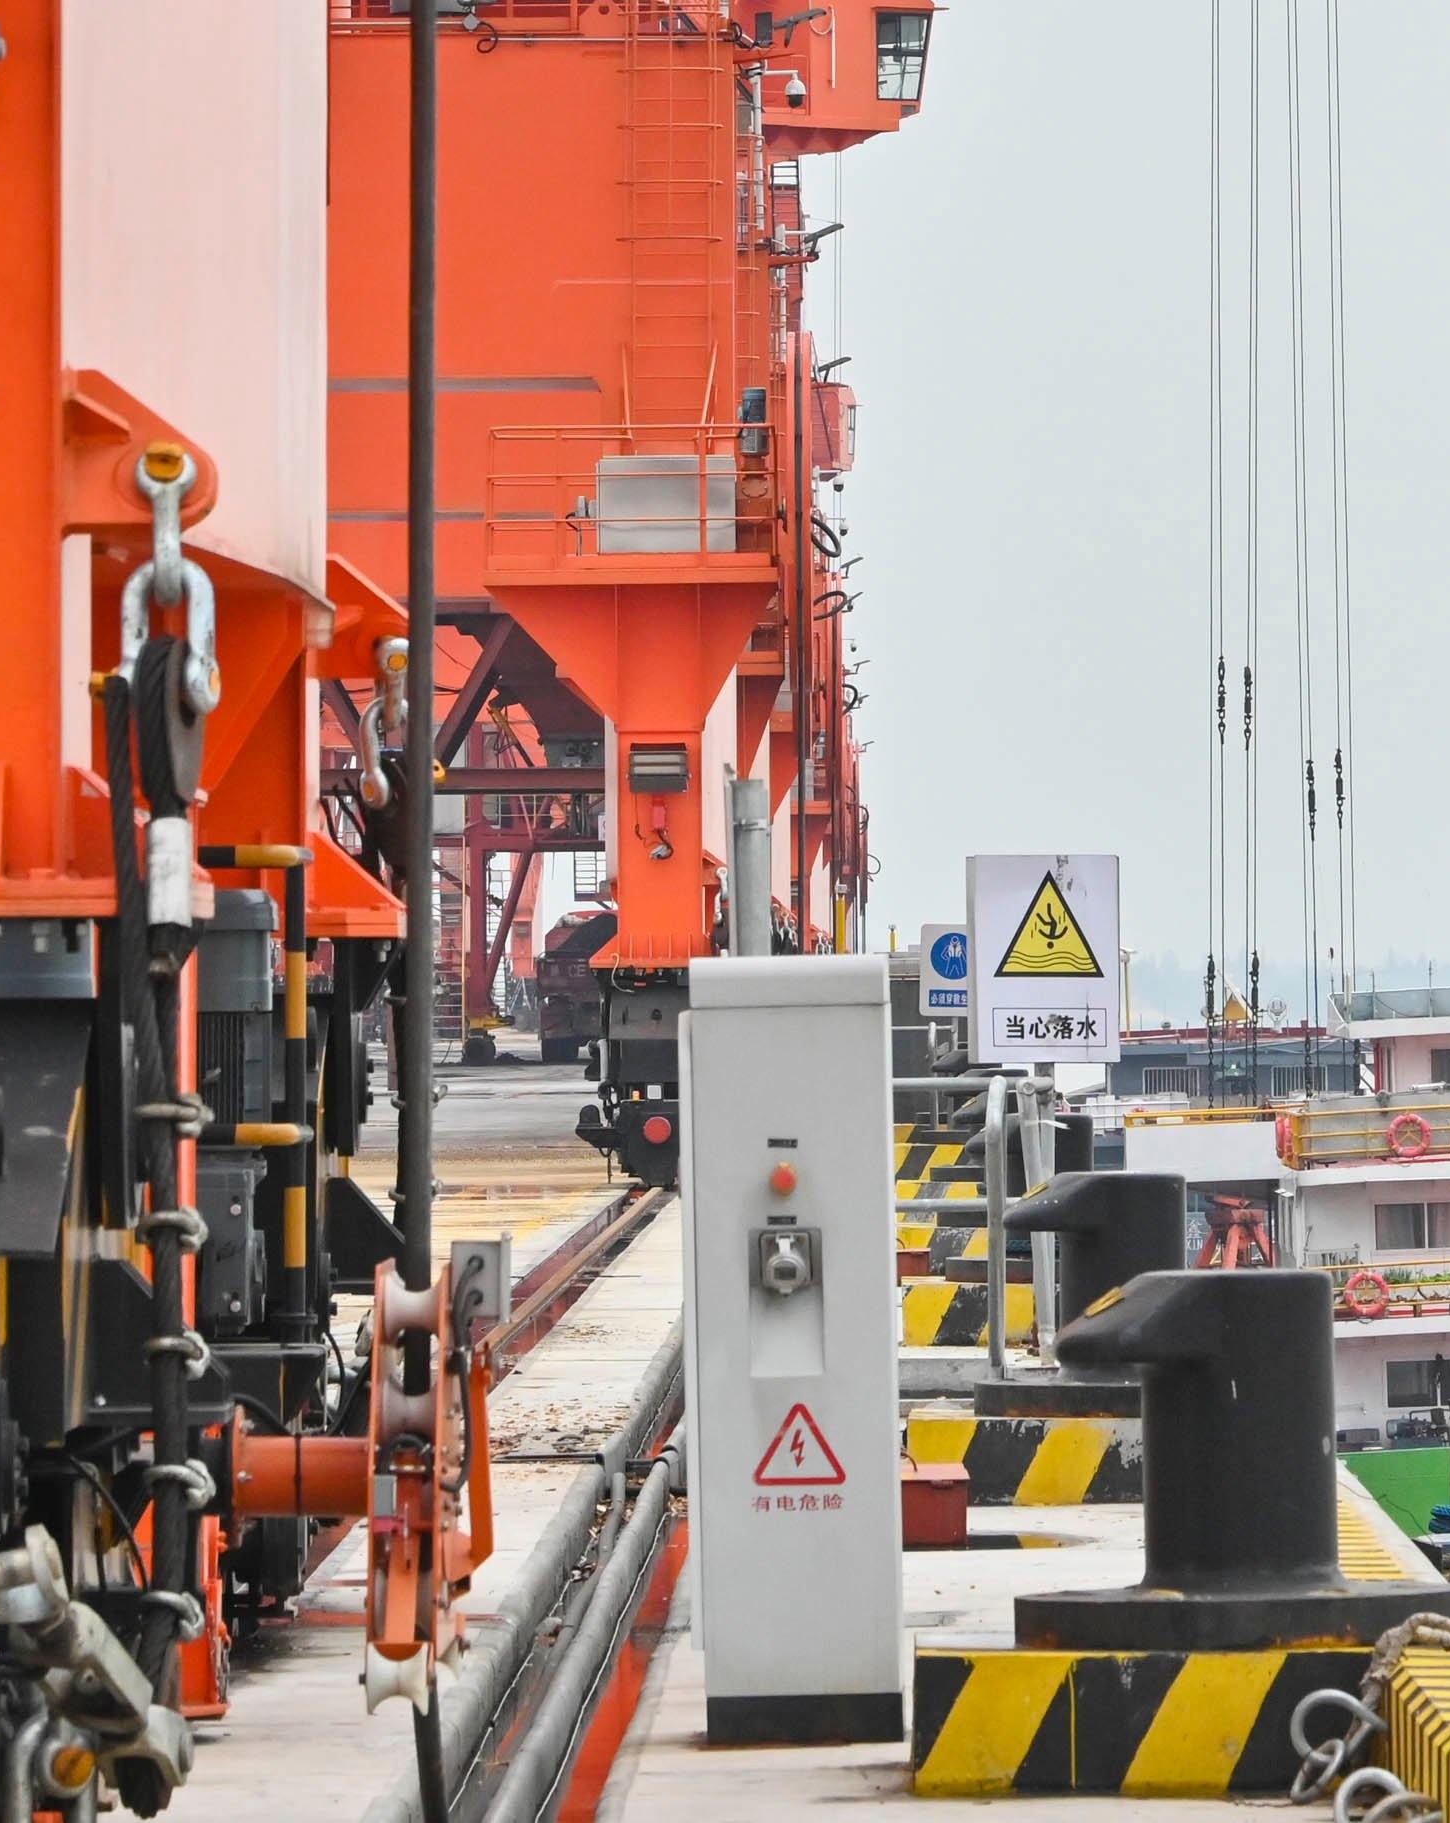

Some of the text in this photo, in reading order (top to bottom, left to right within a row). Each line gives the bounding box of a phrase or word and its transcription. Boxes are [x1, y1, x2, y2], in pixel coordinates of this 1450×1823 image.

[930, 992, 968, 1005] 必须穿救生
[1006, 1014, 1098, 1040] 当心落水
[751, 1493, 845, 1513] 有电危险
